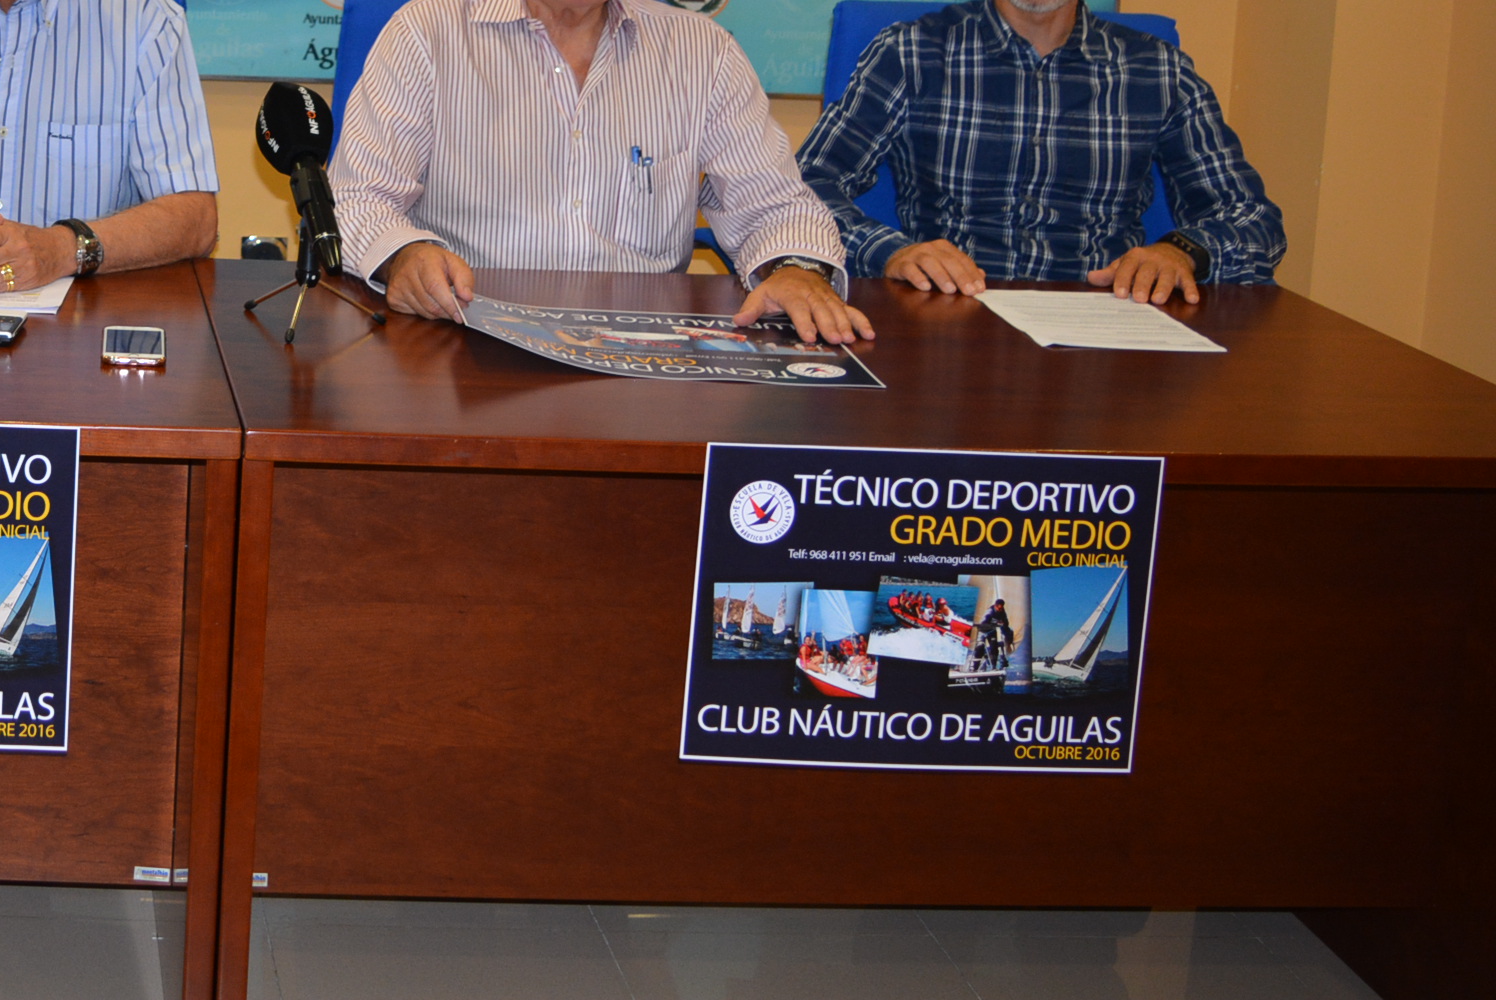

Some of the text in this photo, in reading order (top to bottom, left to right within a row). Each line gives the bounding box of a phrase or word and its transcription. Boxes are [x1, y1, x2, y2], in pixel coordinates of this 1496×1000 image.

[572, 313, 608, 322] DE
[586, 351, 696, 366] GRADO
[660, 362, 798, 379] TÉCNICO
[733, 483, 792, 510] ESCUELA DE VELA
[794, 470, 1136, 515] TÉCNICO DEPORTIVO
[890, 514, 1131, 550] GRADO MEDIO
[788, 548, 1002, 566] Telf: 968 411 951 Email vela@cnaguilas.com
[1026, 552, 1128, 569] CICLO INICIAL
[18, 722, 56, 739] 2016
[698, 704, 1122, 744] CLUB NÁUTICO DE AGUILAS
[1014, 745, 1120, 762] OCTUBRE 2016
